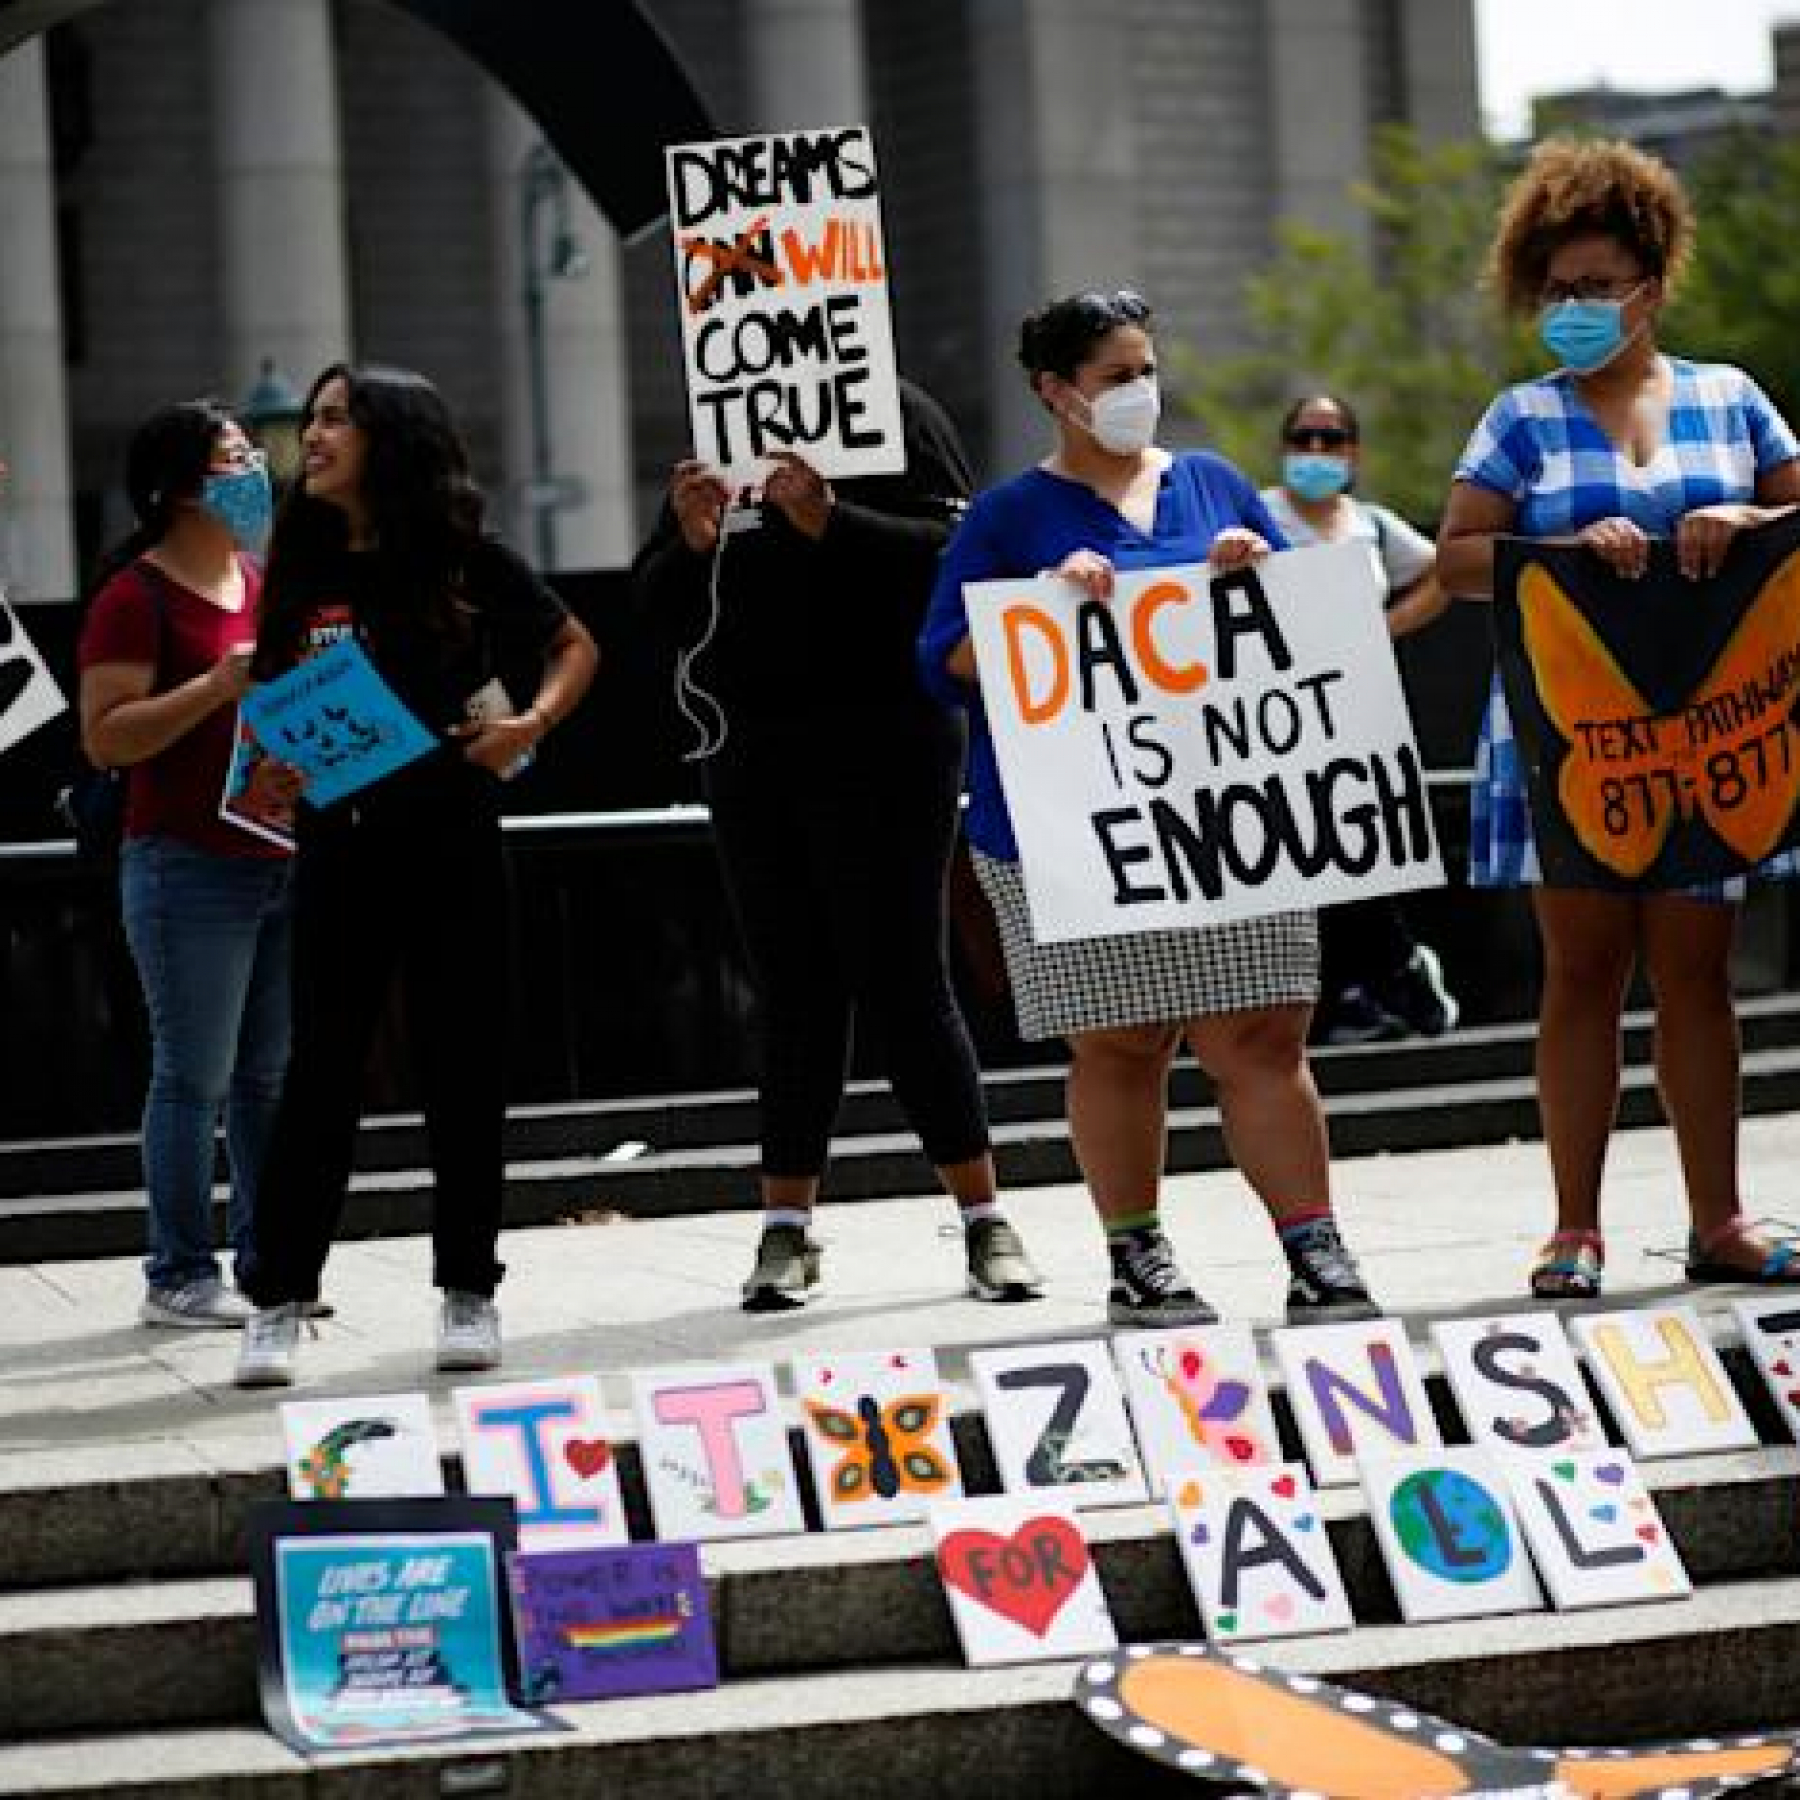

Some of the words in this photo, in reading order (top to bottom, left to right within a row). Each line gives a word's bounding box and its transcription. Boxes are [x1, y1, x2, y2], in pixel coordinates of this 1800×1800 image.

[673, 129, 878, 226] DREAMS
[780, 217, 885, 287] WILL
[697, 295, 869, 383] COME
[697, 367, 885, 467] TRUE
[1001, 566, 1293, 725] DACA
[1101, 715, 1174, 789] IS
[1202, 669, 1344, 767] NOT
[1573, 715, 1660, 763] TEXT
[1090, 742, 1431, 905] ENOUGH
[968, 1532, 1085, 1601] FOR
